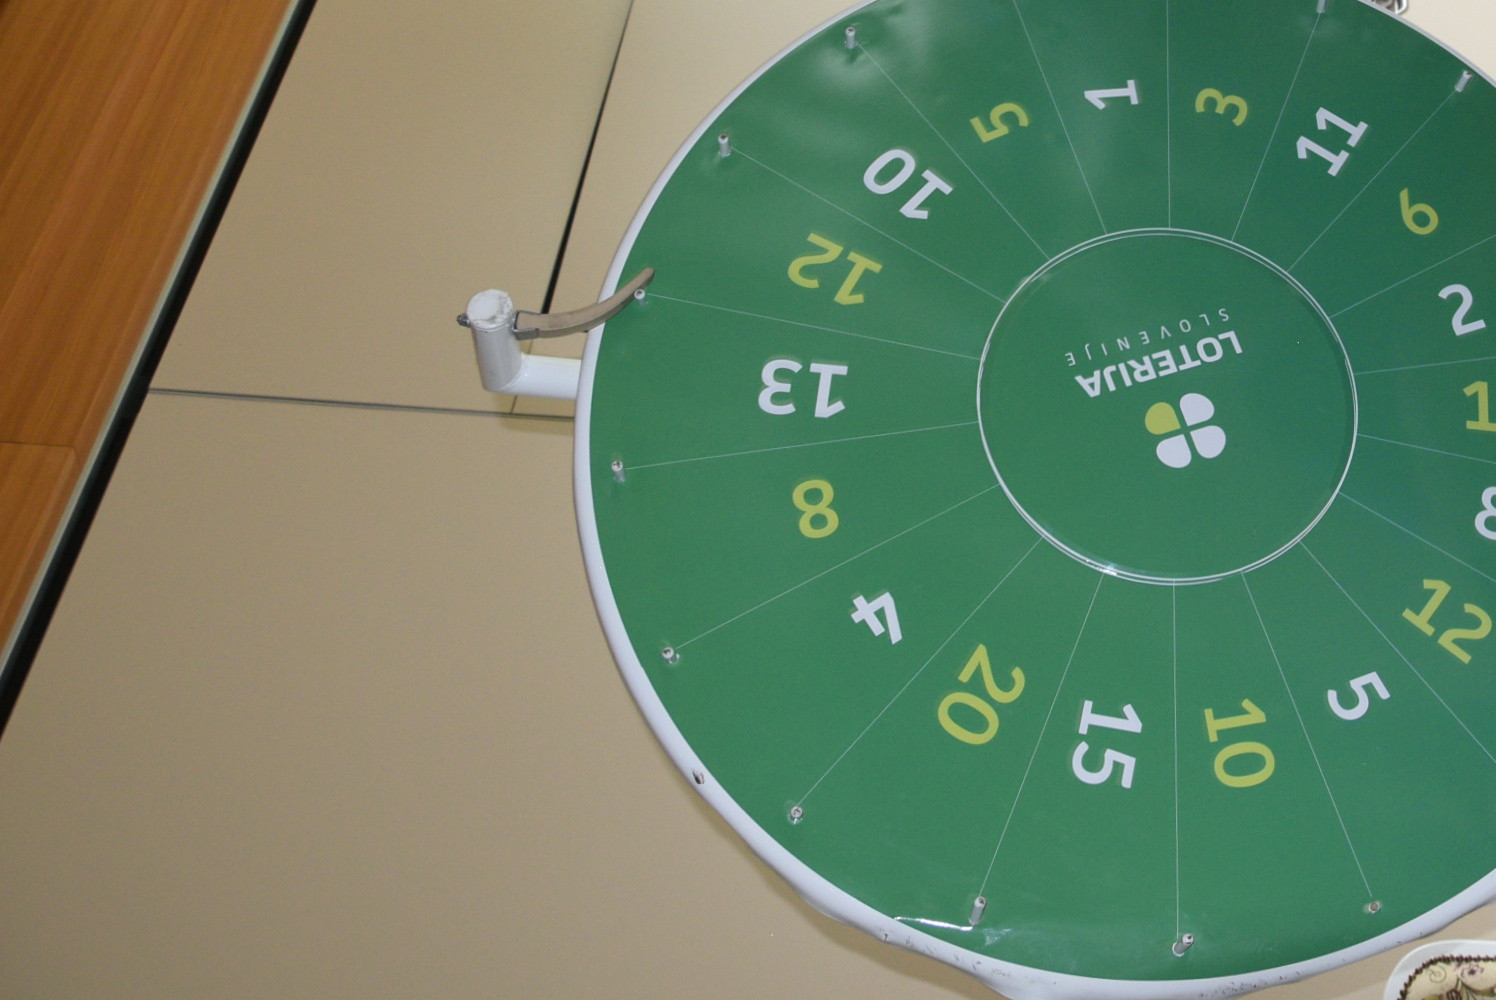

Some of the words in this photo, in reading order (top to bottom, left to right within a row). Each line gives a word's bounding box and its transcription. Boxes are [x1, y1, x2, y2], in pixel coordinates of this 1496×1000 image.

[970, 102, 1029, 143] 5
[1083, 79, 1139, 110] 1
[1195, 87, 1249, 127] 3
[1296, 107, 1368, 177] 11
[863, 148, 954, 220] 10
[1399, 188, 1440, 236] 6
[787, 232, 883, 305] 12
[1065, 308, 1230, 367] SLOVENIJE
[1438, 283, 1486, 336] 2
[757, 358, 849, 419] 13
[1074, 330, 1243, 398] LOTERIJA
[792, 479, 839, 539] 8
[850, 591, 903, 645] 4
[1402, 579, 1493, 664] 12
[937, 643, 1025, 745] 20
[1327, 671, 1391, 721] 5
[1071, 699, 1143, 789] 15
[1204, 698, 1276, 788] 10
